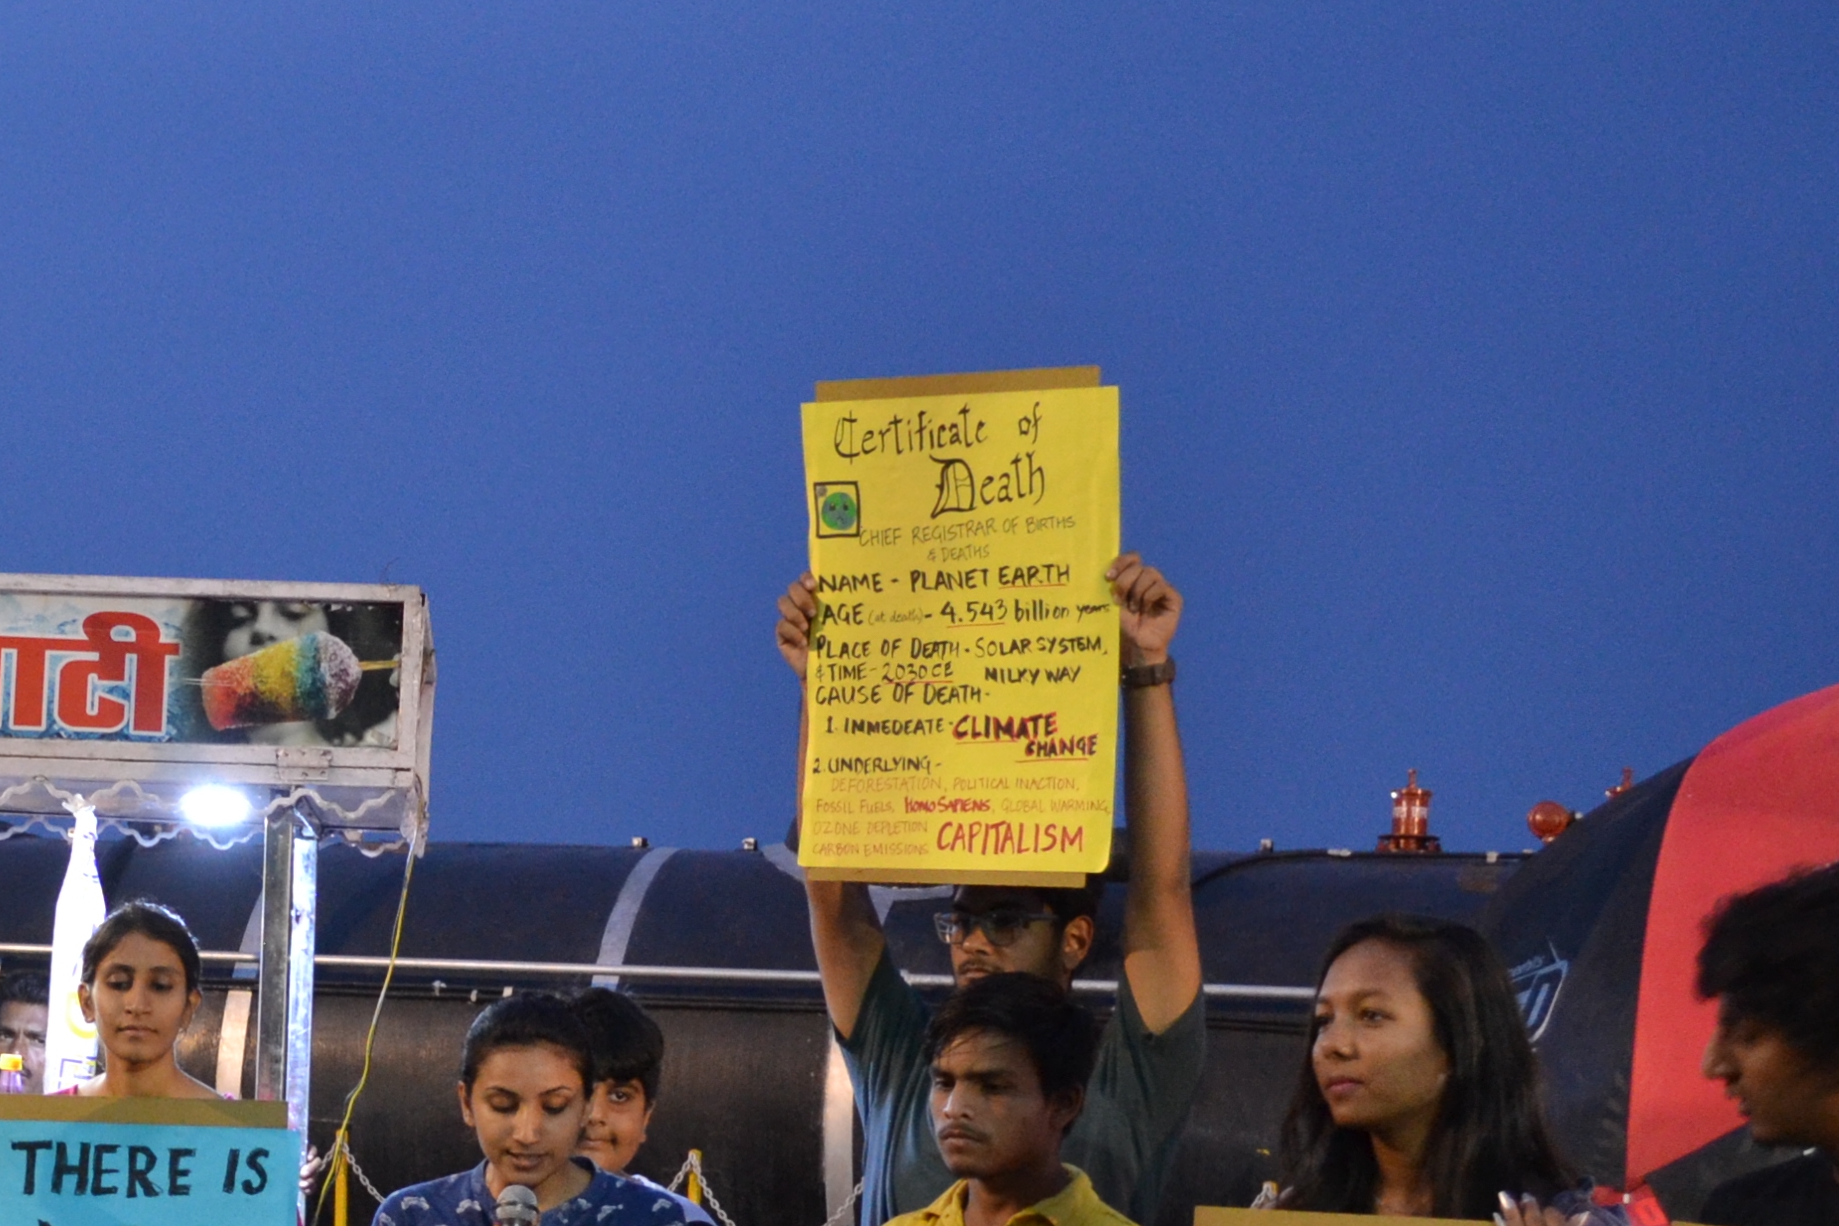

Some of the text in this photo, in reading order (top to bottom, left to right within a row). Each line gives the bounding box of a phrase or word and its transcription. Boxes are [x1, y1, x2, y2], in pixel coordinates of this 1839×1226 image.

[835, 401, 1042, 464] Certificate of
[929, 451, 1045, 519] Death
[859, 515, 1076, 547] CHIEF REGISTRAR OF BIRTHS
[942, 544, 990, 562] DEATHS
[818, 571, 883, 593] NAME
[910, 569, 989, 593] PLANET
[998, 564, 1070, 587] EARTH
[822, 602, 864, 626] AGE
[940, 598, 1008, 624] 4.543
[1014, 598, 1070, 623] billion
[1076, 602, 1111, 623] years
[881, 638, 902, 658] OF
[975, 637, 1032, 658] SOLAR
[827, 662, 867, 682] TIME
[984, 665, 1081, 686] MILKY WAY
[815, 684, 882, 706] CAUSE
[893, 682, 915, 705] OF
[952, 711, 1059, 741] CLIMATE
[1025, 733, 1098, 757] CHANGE
[828, 755, 931, 775] UNDERLYING
[953, 777, 1010, 791] POLITICAL
[816, 798, 853, 814] FOSSIL
[1001, 799, 1045, 813] GLOBAL
[813, 821, 928, 837] OZONE DEPLETION
[936, 820, 1083, 855] CAPITALISM
[812, 843, 929, 857] CARBON EMISSIONS
[9, 1139, 270, 1198] THERE IS
